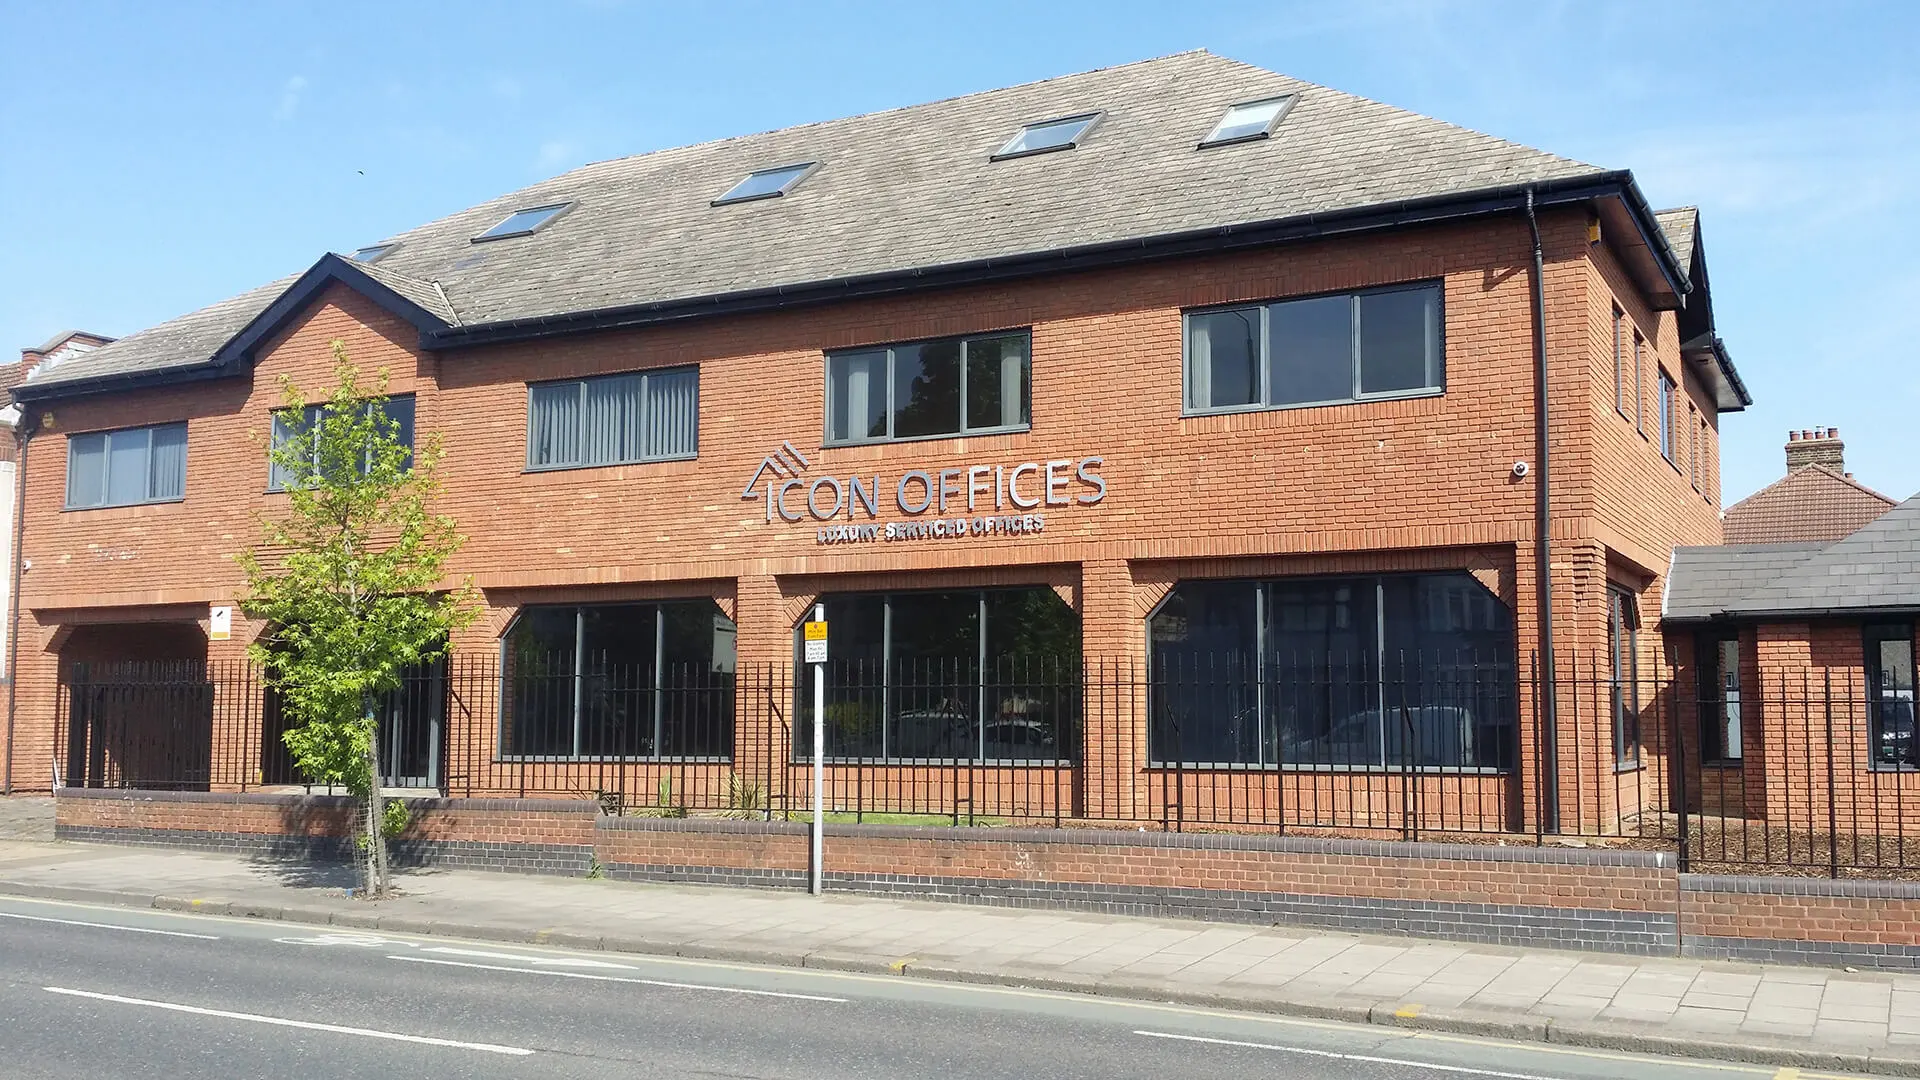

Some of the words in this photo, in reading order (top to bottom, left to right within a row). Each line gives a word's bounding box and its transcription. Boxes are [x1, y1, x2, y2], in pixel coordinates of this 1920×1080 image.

[765, 472, 880, 521] ICON
[897, 456, 1107, 514] OFFICES
[817, 523, 881, 543] LUXURY
[885, 518, 967, 540] SERVICED
[971, 513, 1045, 535] OFFICES
